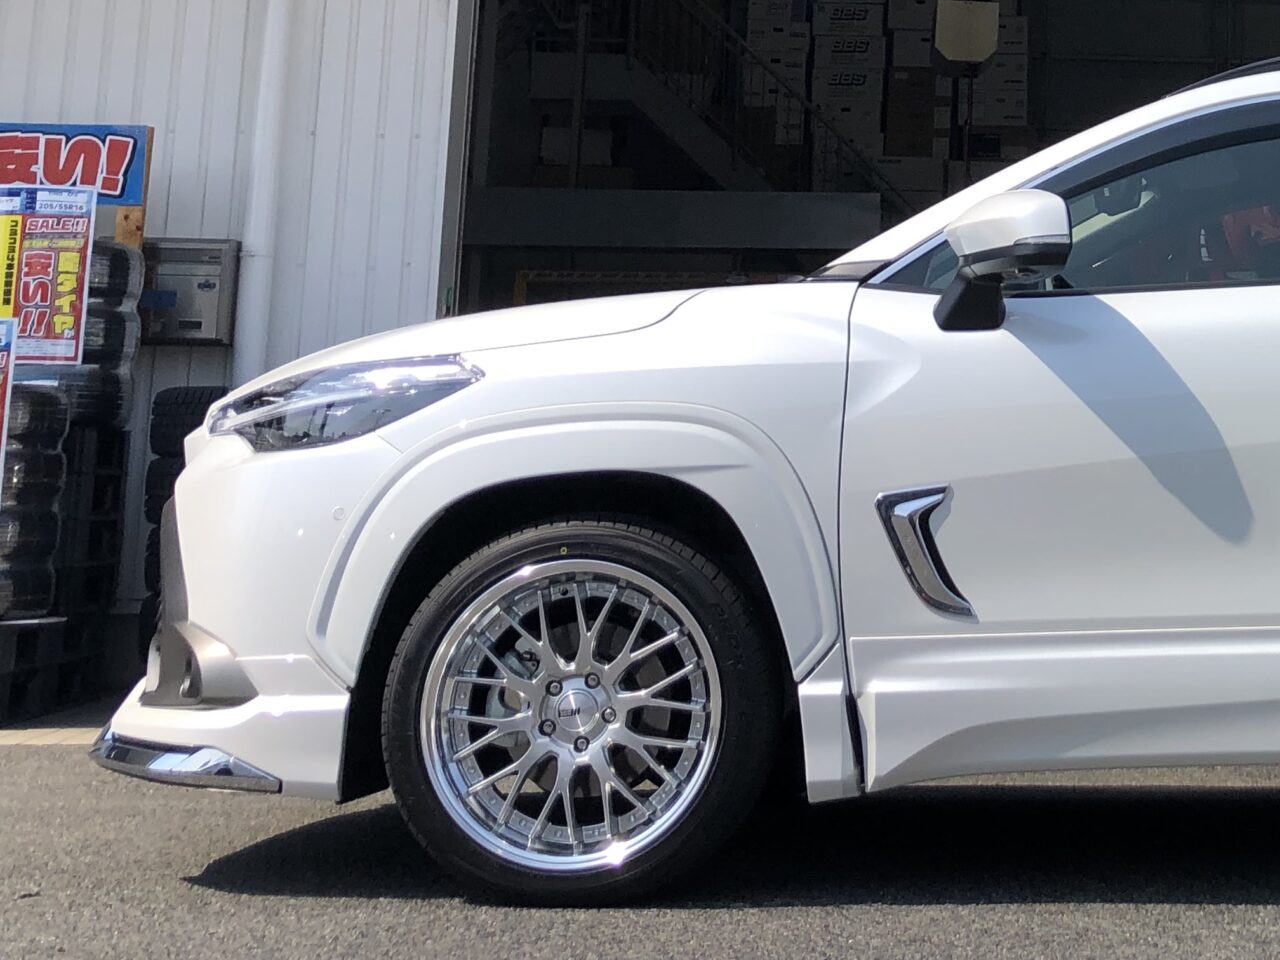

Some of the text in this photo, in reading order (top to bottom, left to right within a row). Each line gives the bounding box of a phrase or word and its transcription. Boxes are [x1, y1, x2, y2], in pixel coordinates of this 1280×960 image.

[829, 6, 869, 21] BBS
[830, 38, 870, 54] BBS
[827, 71, 867, 86] BBS
[25, 218, 88, 233] SALE!!
